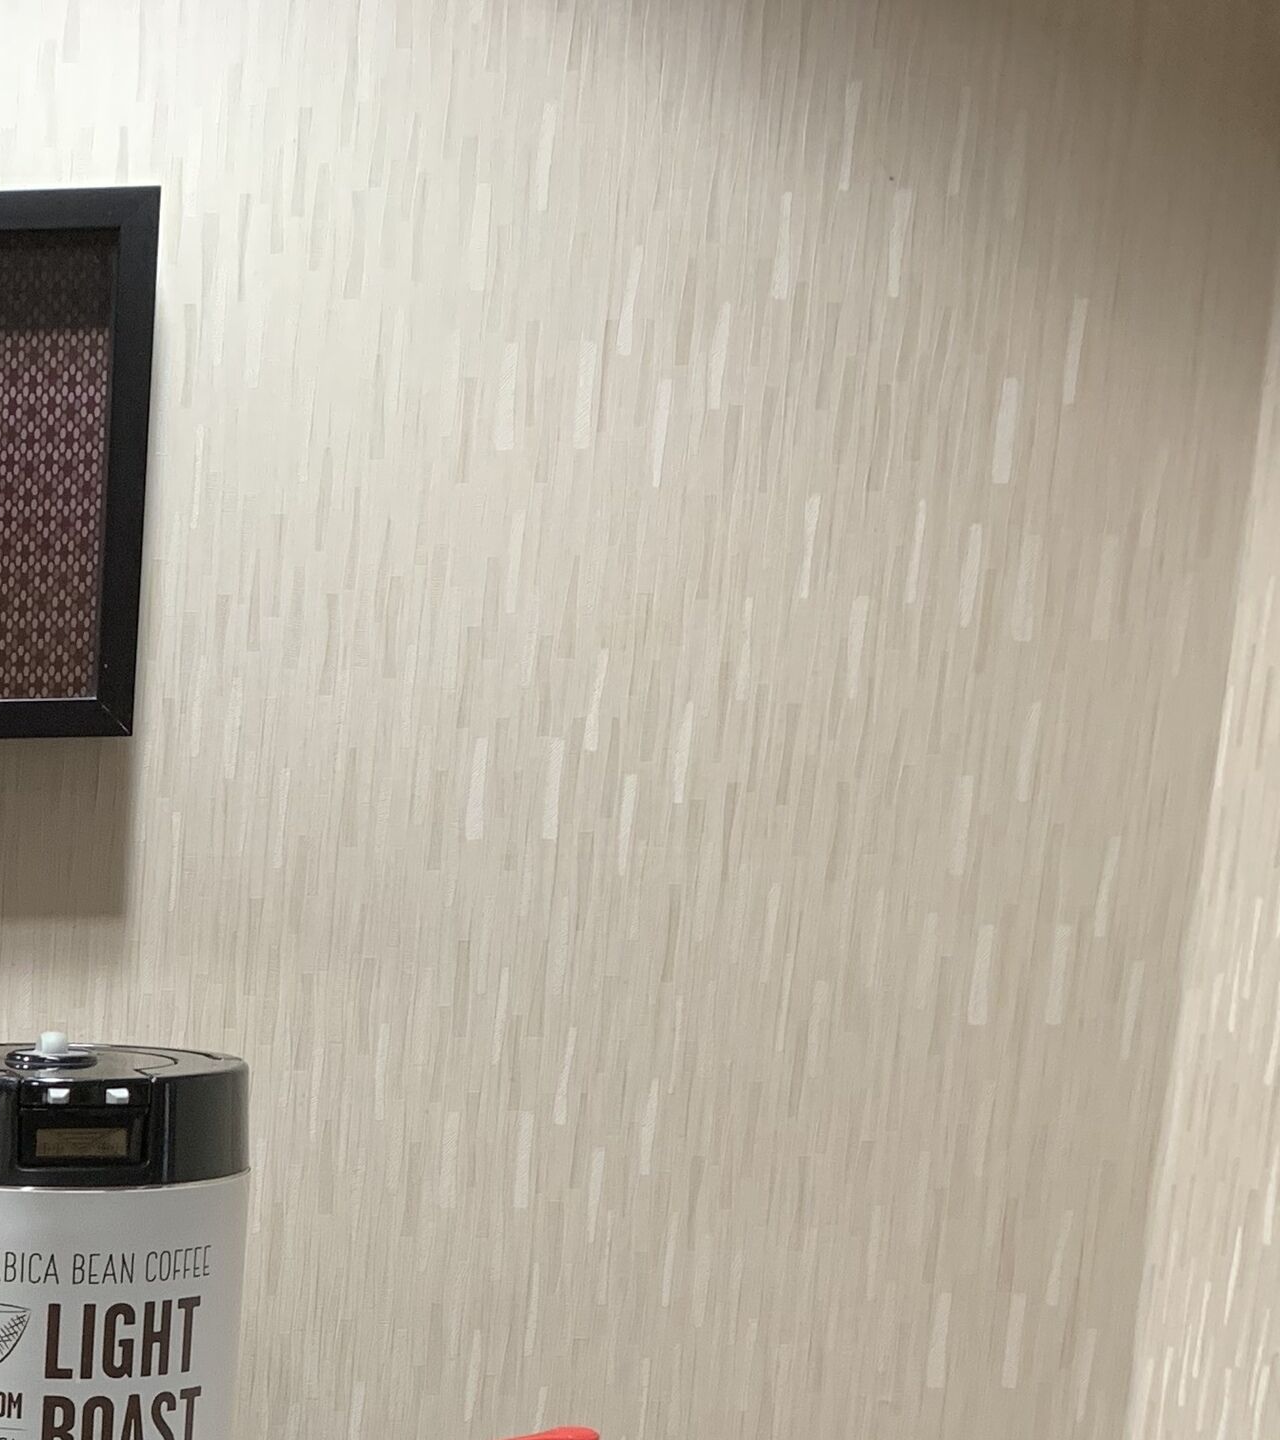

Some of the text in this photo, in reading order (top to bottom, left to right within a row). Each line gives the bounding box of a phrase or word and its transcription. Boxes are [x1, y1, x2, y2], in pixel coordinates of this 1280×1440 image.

[71, 1251, 136, 1286] BEAN
[144, 1244, 213, 1283] COFFEE
[43, 1294, 202, 1380] LIGHT
